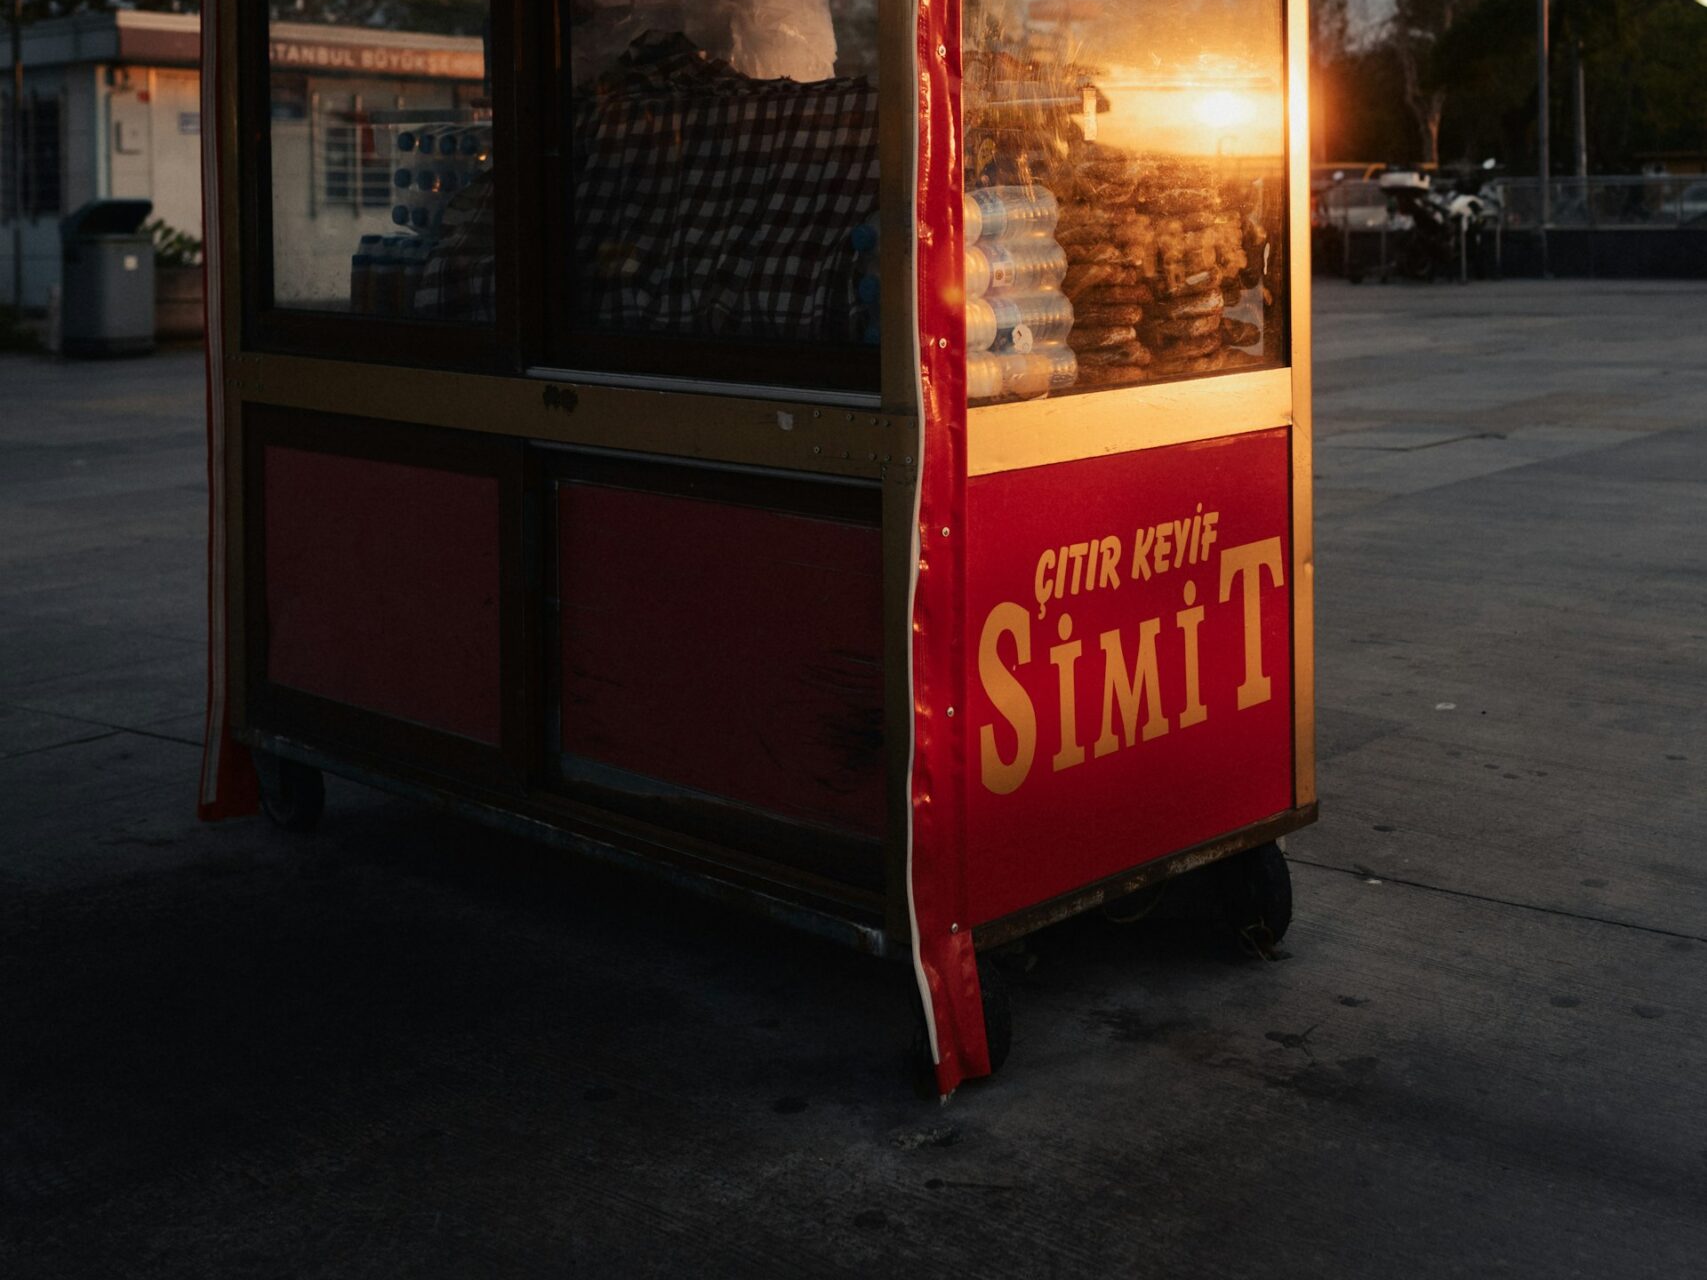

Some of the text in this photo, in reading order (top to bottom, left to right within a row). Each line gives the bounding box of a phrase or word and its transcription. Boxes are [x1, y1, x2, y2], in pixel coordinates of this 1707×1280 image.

[1034, 502, 1219, 620] ÇITIR KEYİF
[978, 536, 1285, 795] SİMİT
